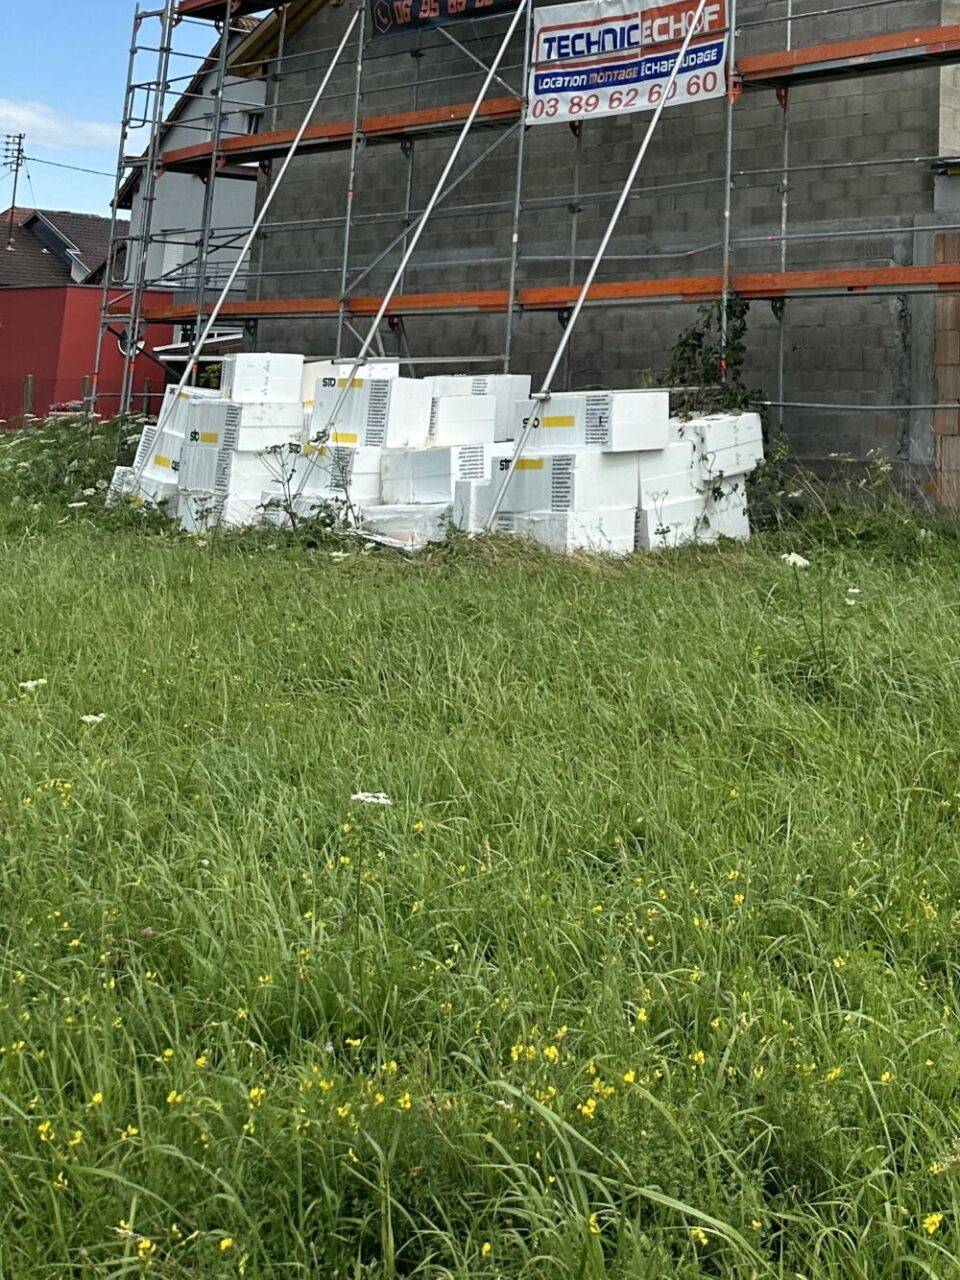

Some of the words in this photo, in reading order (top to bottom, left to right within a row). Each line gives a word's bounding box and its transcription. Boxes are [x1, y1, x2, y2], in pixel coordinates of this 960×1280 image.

[393, 0, 412, 24] 06
[532, 97, 559, 118] 03
[568, 94, 599, 115] 89
[608, 88, 639, 109] 62
[648, 80, 677, 103] 60
[687, 71, 717, 96] 60
[522, 417, 540, 429] so
[499, 458, 514, 471] st
